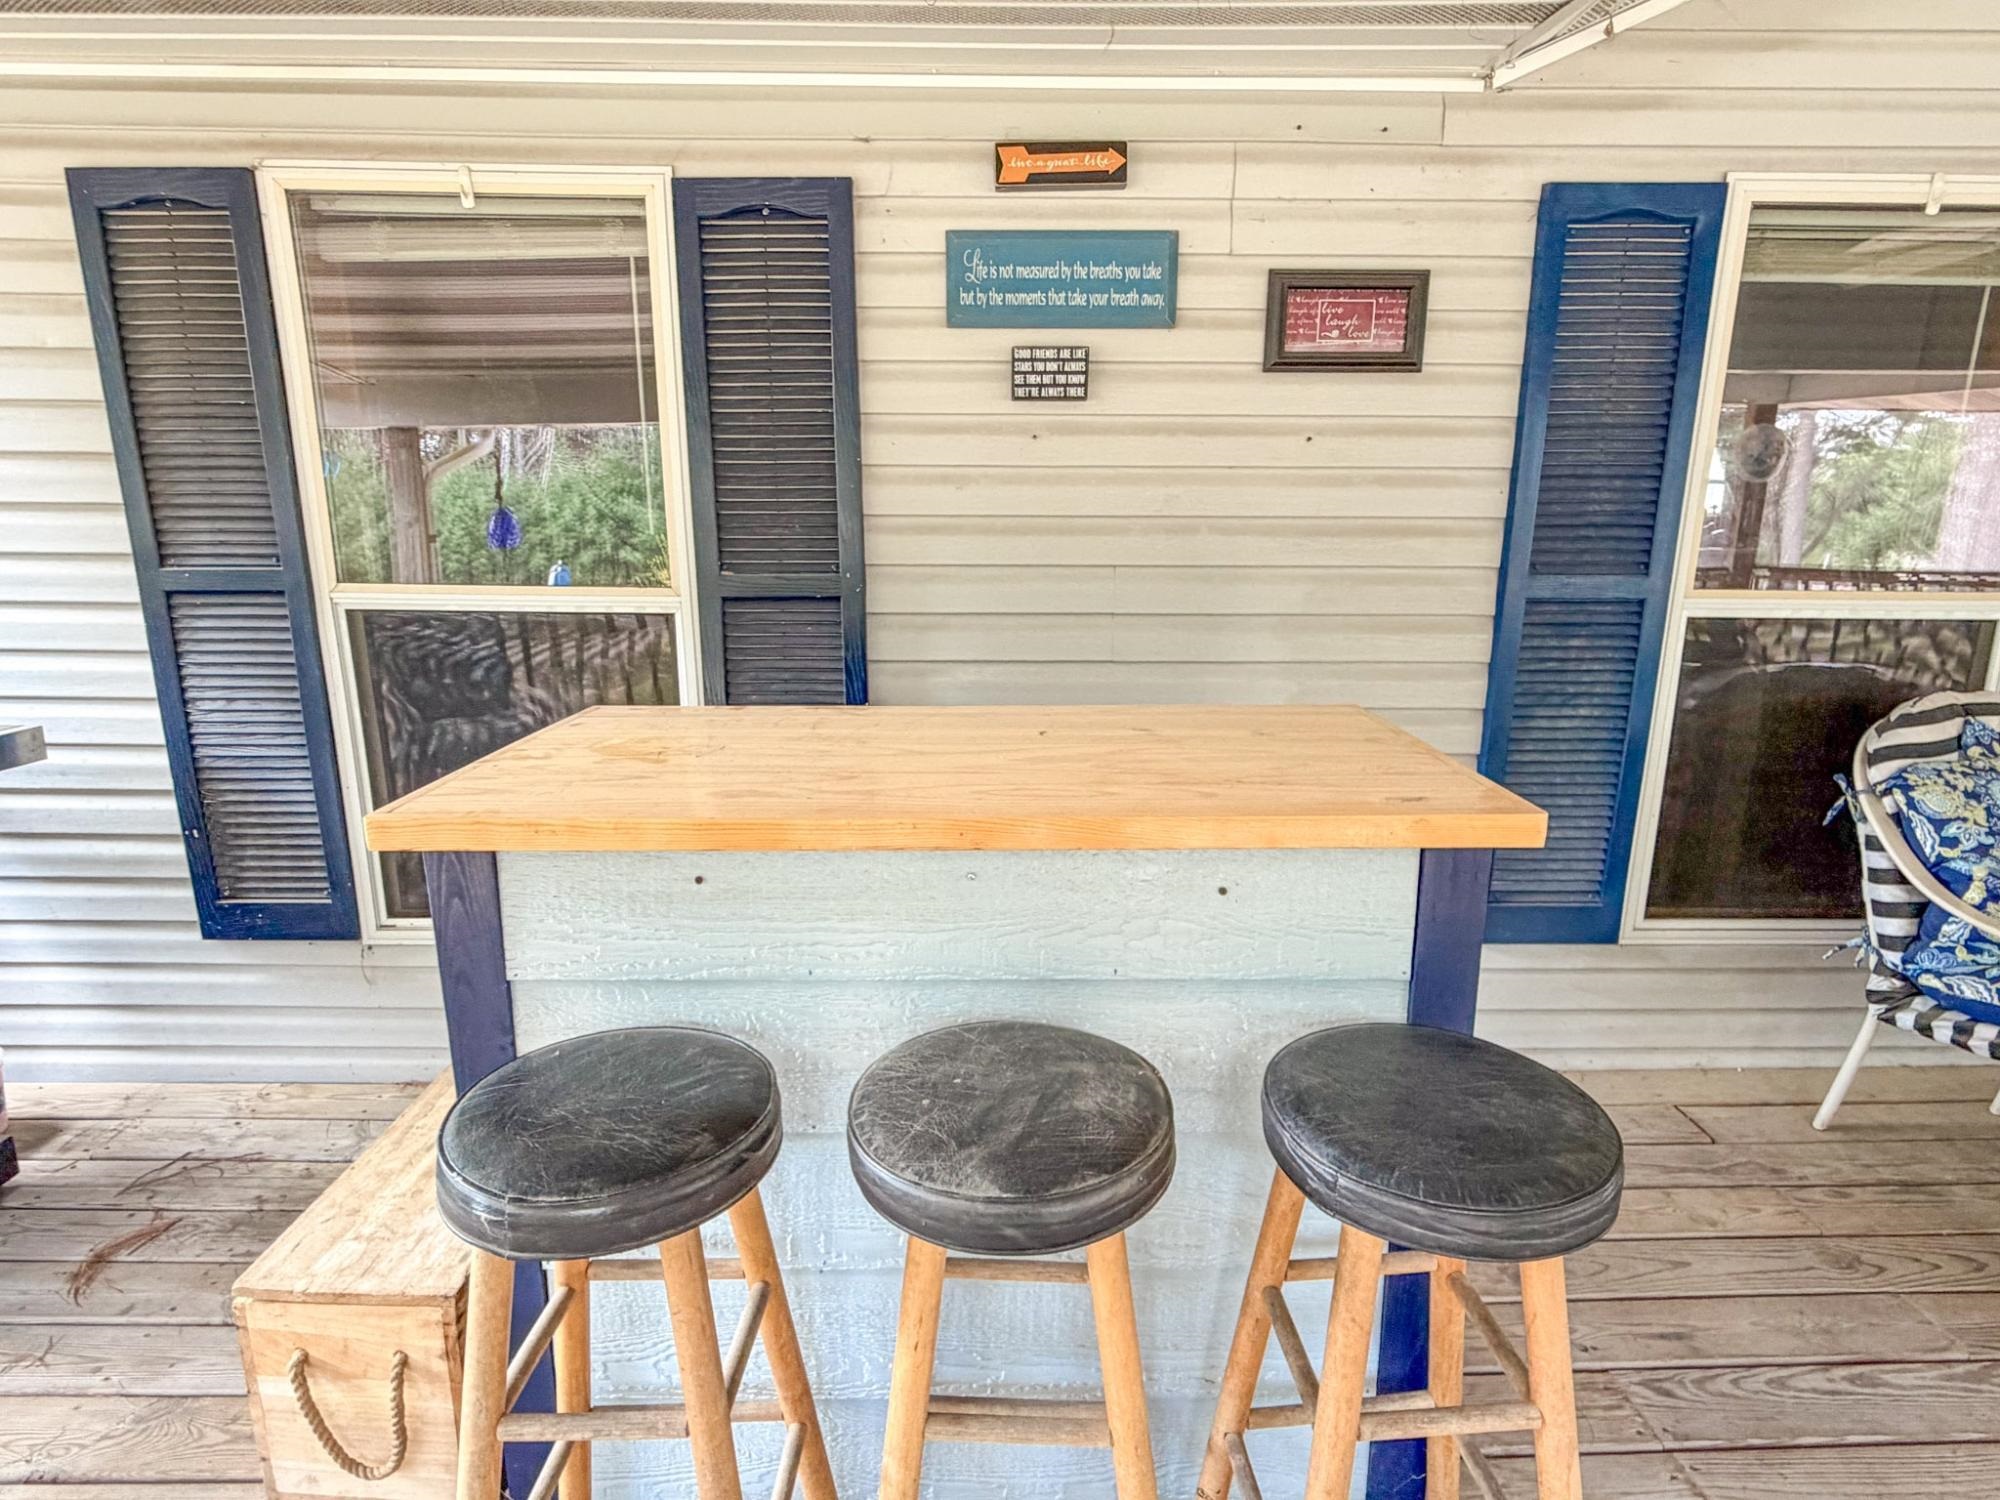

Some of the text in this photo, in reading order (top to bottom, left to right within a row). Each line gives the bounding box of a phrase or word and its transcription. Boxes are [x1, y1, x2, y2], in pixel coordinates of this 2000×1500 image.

[1045, 158, 1079, 171] great
[1081, 153, 1116, 168] life
[963, 248, 1162, 284] Life is not measured by the breaths you take
[959, 286, 1165, 309] but by the moments that take your breath away.
[1321, 301, 1344, 315] live
[1325, 313, 1360, 331] laugh
[1347, 325, 1371, 338] love
[1014, 348, 1086, 359] GOOD FRIENDS ARE LIKE
[1014, 361, 1086, 372] STARS YOU DON'T ALWAYS
[1014, 374, 1086, 385] SEE THEM BUT YOU KNOW
[1014, 387, 1086, 398] THEY'RE ALWAYS THERE
